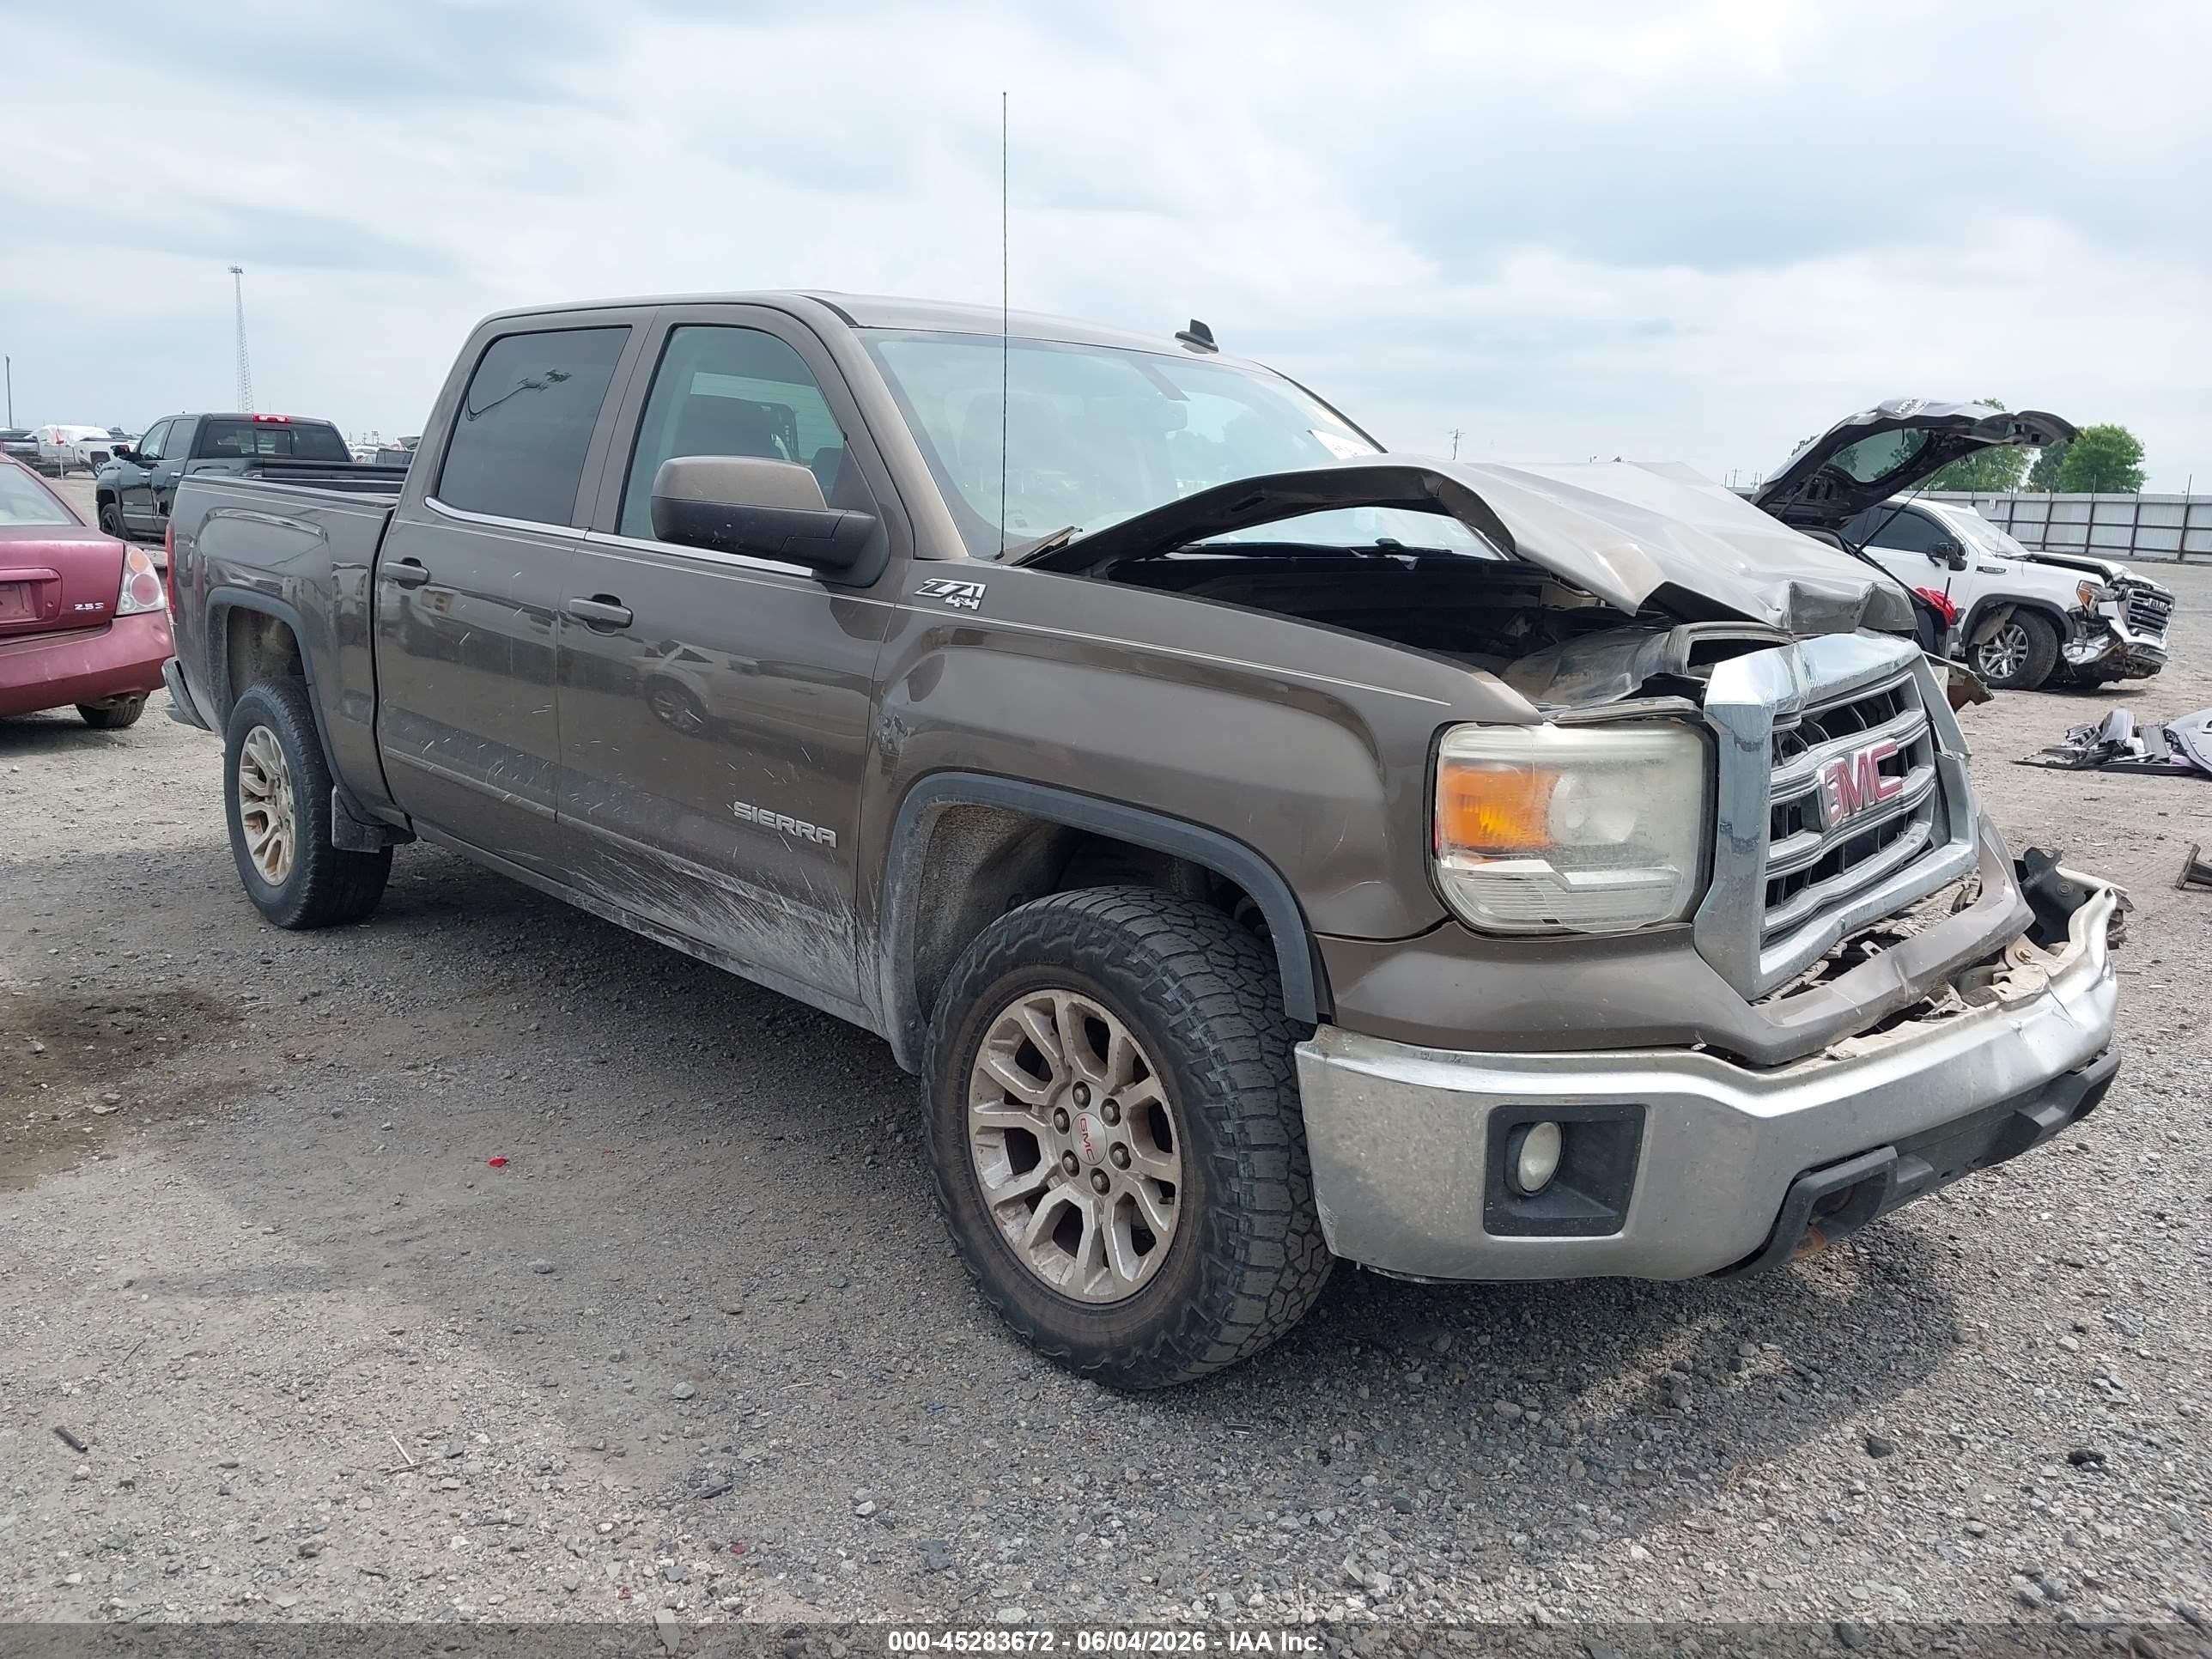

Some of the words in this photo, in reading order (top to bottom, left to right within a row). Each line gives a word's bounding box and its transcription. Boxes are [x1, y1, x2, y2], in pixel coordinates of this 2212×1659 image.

[913, 577, 987, 599] Z71
[734, 801, 836, 848] SIERRA
[1080, 1118, 1095, 1161] GMC
